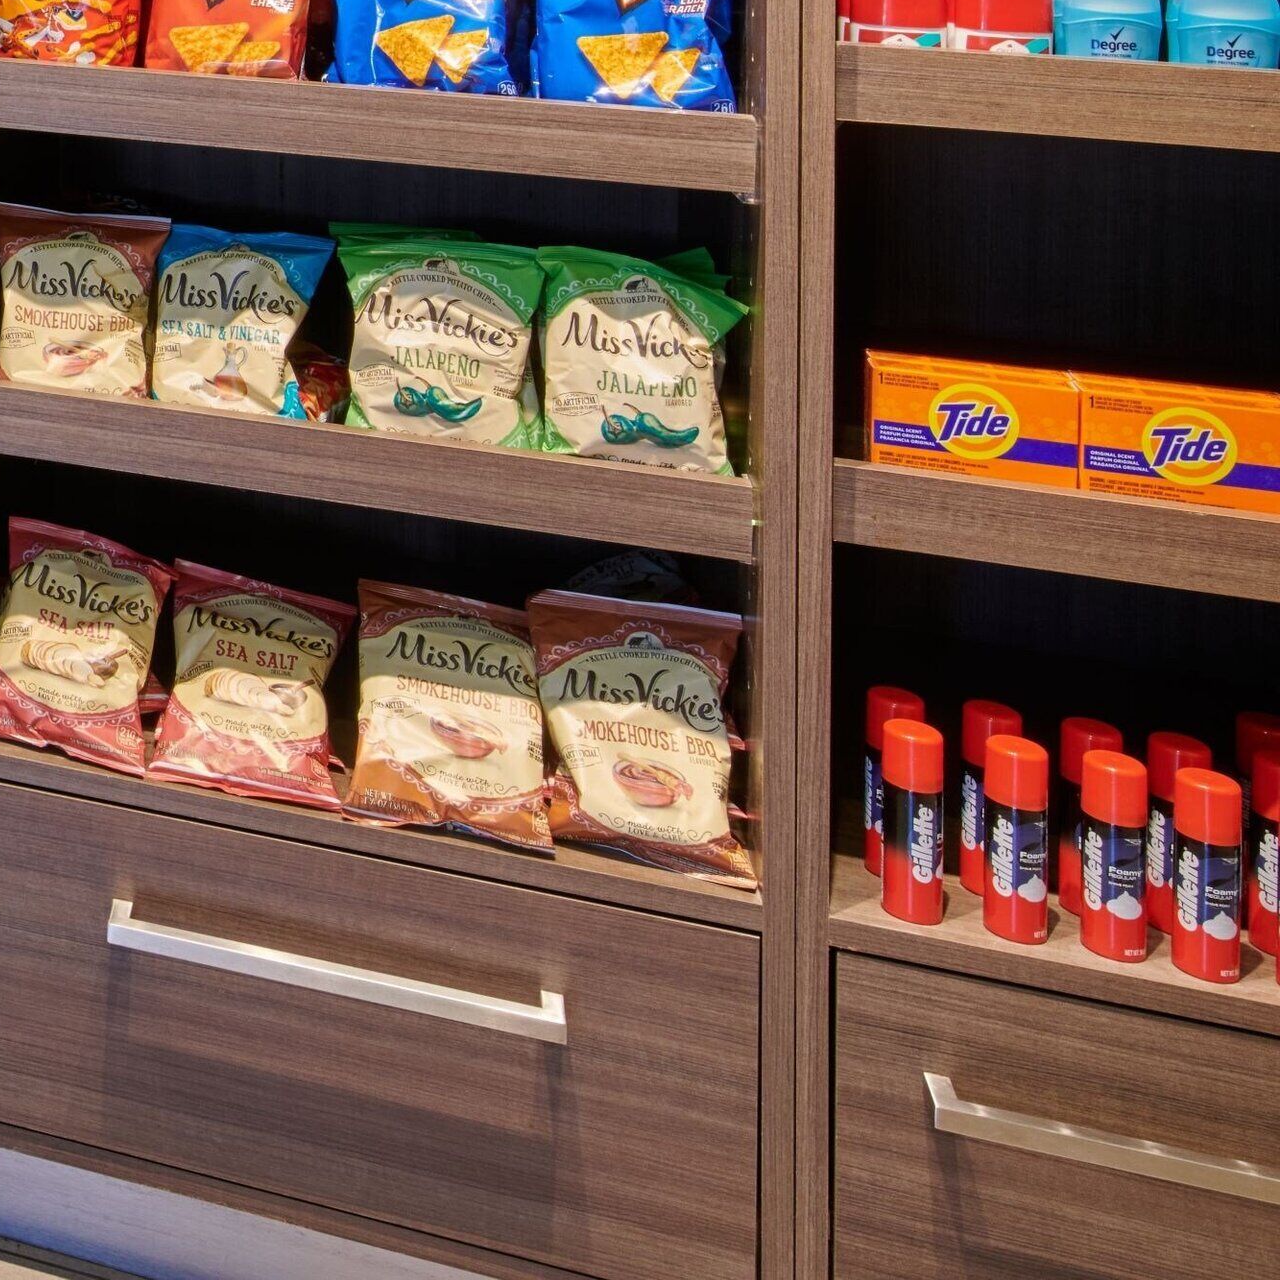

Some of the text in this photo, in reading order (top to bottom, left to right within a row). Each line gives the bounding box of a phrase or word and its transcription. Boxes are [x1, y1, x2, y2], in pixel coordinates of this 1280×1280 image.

[667, 4, 705, 15] RANCH
[1091, 39, 1138, 52] Degree
[1206, 46, 1255, 60] Degree
[160, 270, 296, 324] Miss Vickie's
[161, 319, 280, 345] SEA SALT & VINEGAR
[355, 293, 517, 357] Miss Vickie's
[563, 311, 632, 357] Miss
[393, 345, 480, 380] JALAPEÑO
[597, 371, 699, 398] JALAPEÑO
[879, 424, 904, 432] ORIGINAL
[937, 403, 1010, 442] Tide
[1150, 427, 1227, 467] Tide
[39, 608, 114, 640] SEA SALT
[216, 639, 299, 671] SEA SALT
[589, 651, 679, 663] KETTLE COOKED POTATO
[396, 675, 542, 725] SMOKEHOUSE BBQ
[560, 668, 634, 705] Miss
[912, 805, 933, 883] Gillette
[991, 816, 1013, 897] Gillette
[1084, 828, 1103, 910] Gillette
[1178, 848, 1198, 931] Gillette
